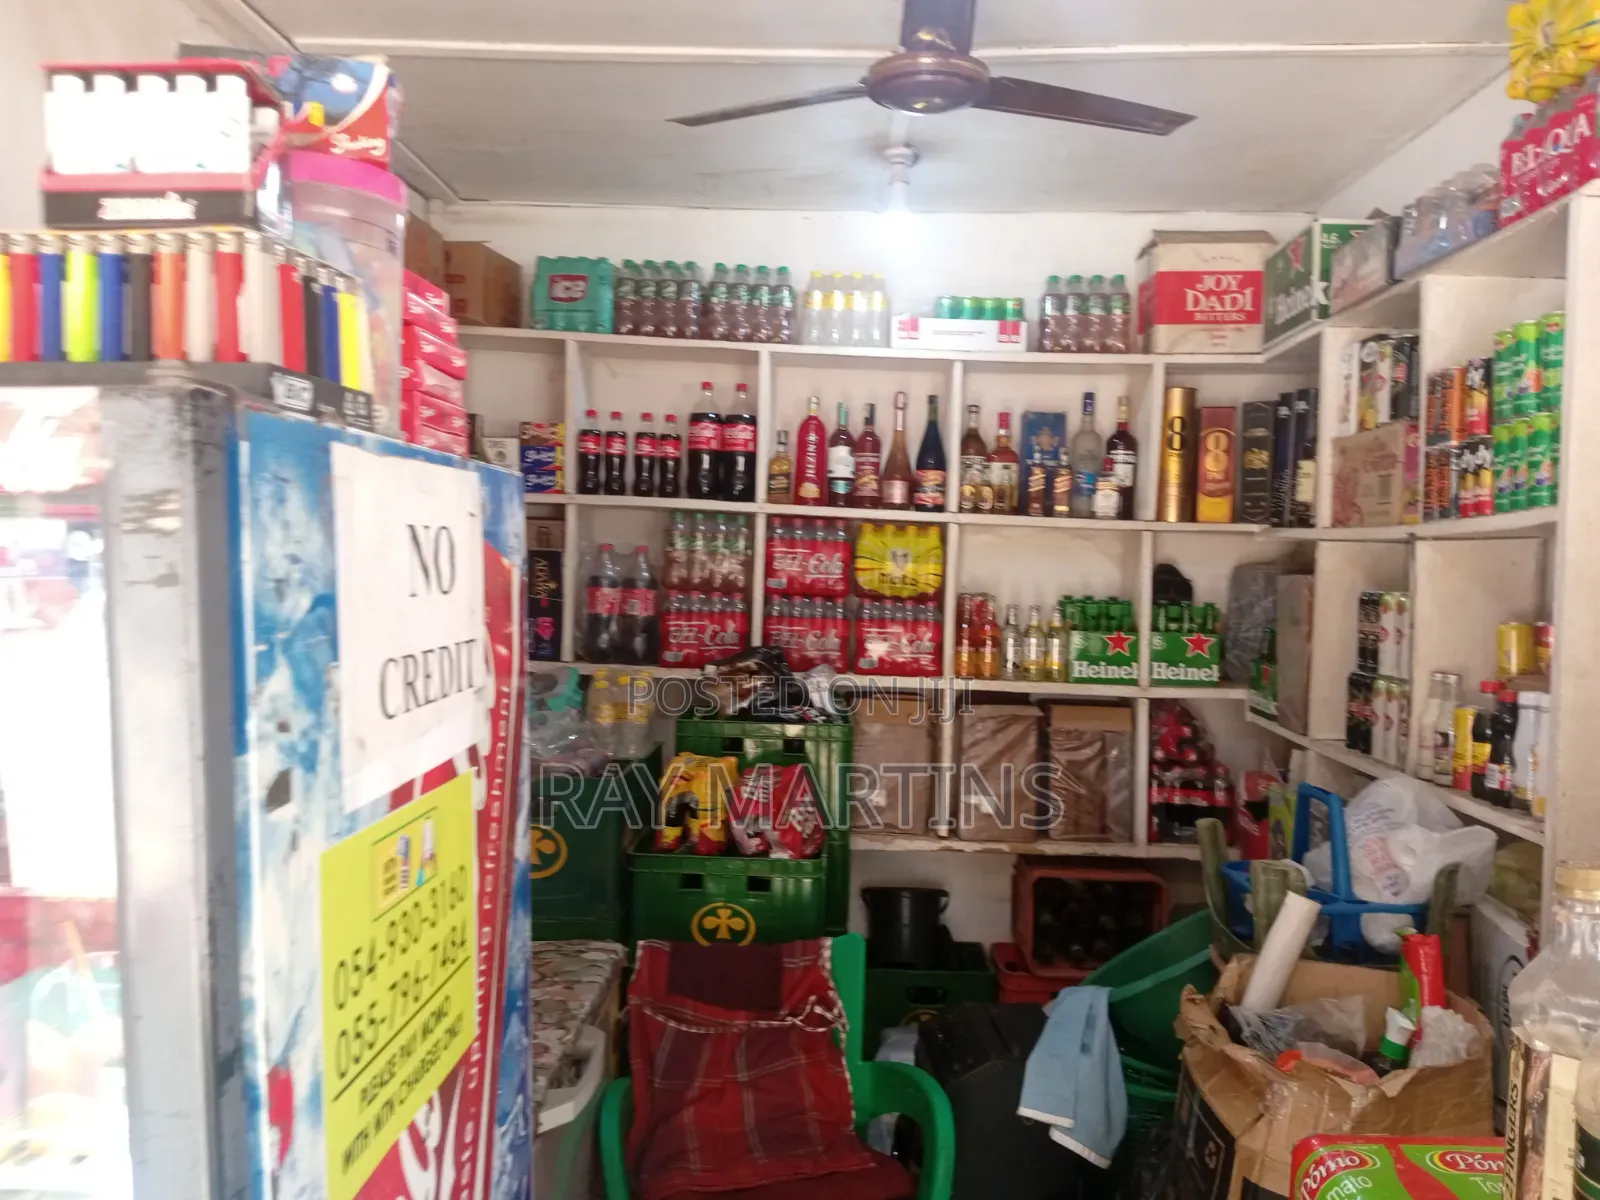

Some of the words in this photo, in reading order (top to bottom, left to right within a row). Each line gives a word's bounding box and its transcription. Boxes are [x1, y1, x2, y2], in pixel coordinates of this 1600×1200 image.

[1184, 286, 1255, 312] DADI
[1195, 274, 1244, 291] JOY
[406, 523, 456, 598] NO
[379, 638, 478, 720] CREDIT
